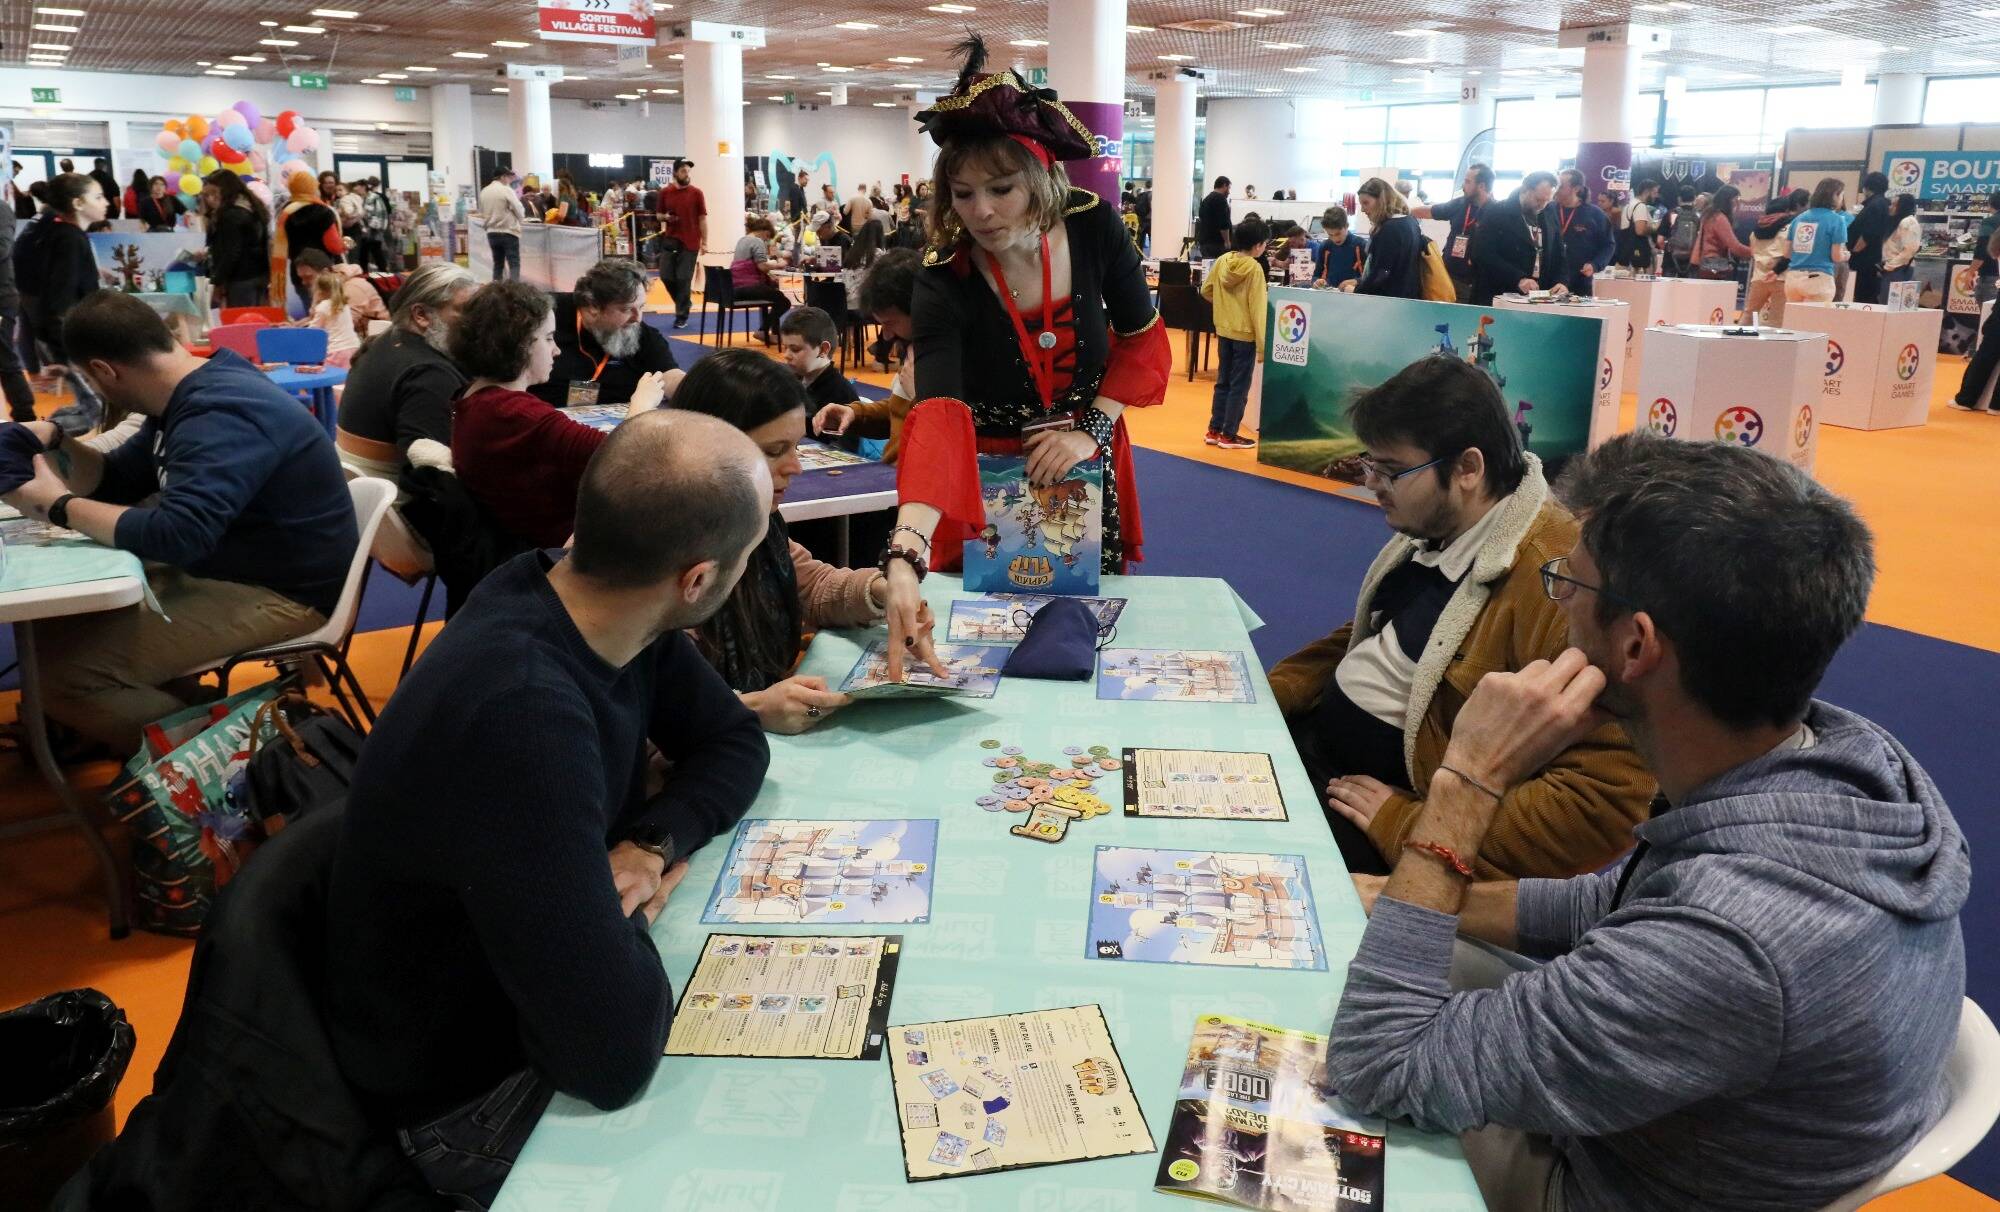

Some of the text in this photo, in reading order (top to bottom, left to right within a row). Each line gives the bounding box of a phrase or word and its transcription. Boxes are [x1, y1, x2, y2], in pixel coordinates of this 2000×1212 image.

[580, 13, 617, 24] SORTIE
[551, 21, 645, 35] VILLAGE FESTIVAL
[1462, 87, 1477, 99] 31
[1130, 107, 1140, 117] 32
[655, 163, 672, 175] DÉB
[1930, 184, 2000, 193] SMART
[1275, 344, 1305, 355] SMART
[1274, 352, 1305, 363] GAMES
[1893, 383, 1916, 391] SMART
[1014, 575, 1049, 586] CAPTAIN
[1019, 1022, 1028, 1032] BUT
[1025, 1042, 1033, 1052] JEU
[1097, 1060, 1117, 1090] CAPTAIN
[1065, 1084, 1075, 1097] MISE
[1073, 1106, 1085, 1125] PLACE
[1225, 1107, 1268, 1123] DEAD?
[1225, 1114, 1270, 1131] BATMAN
